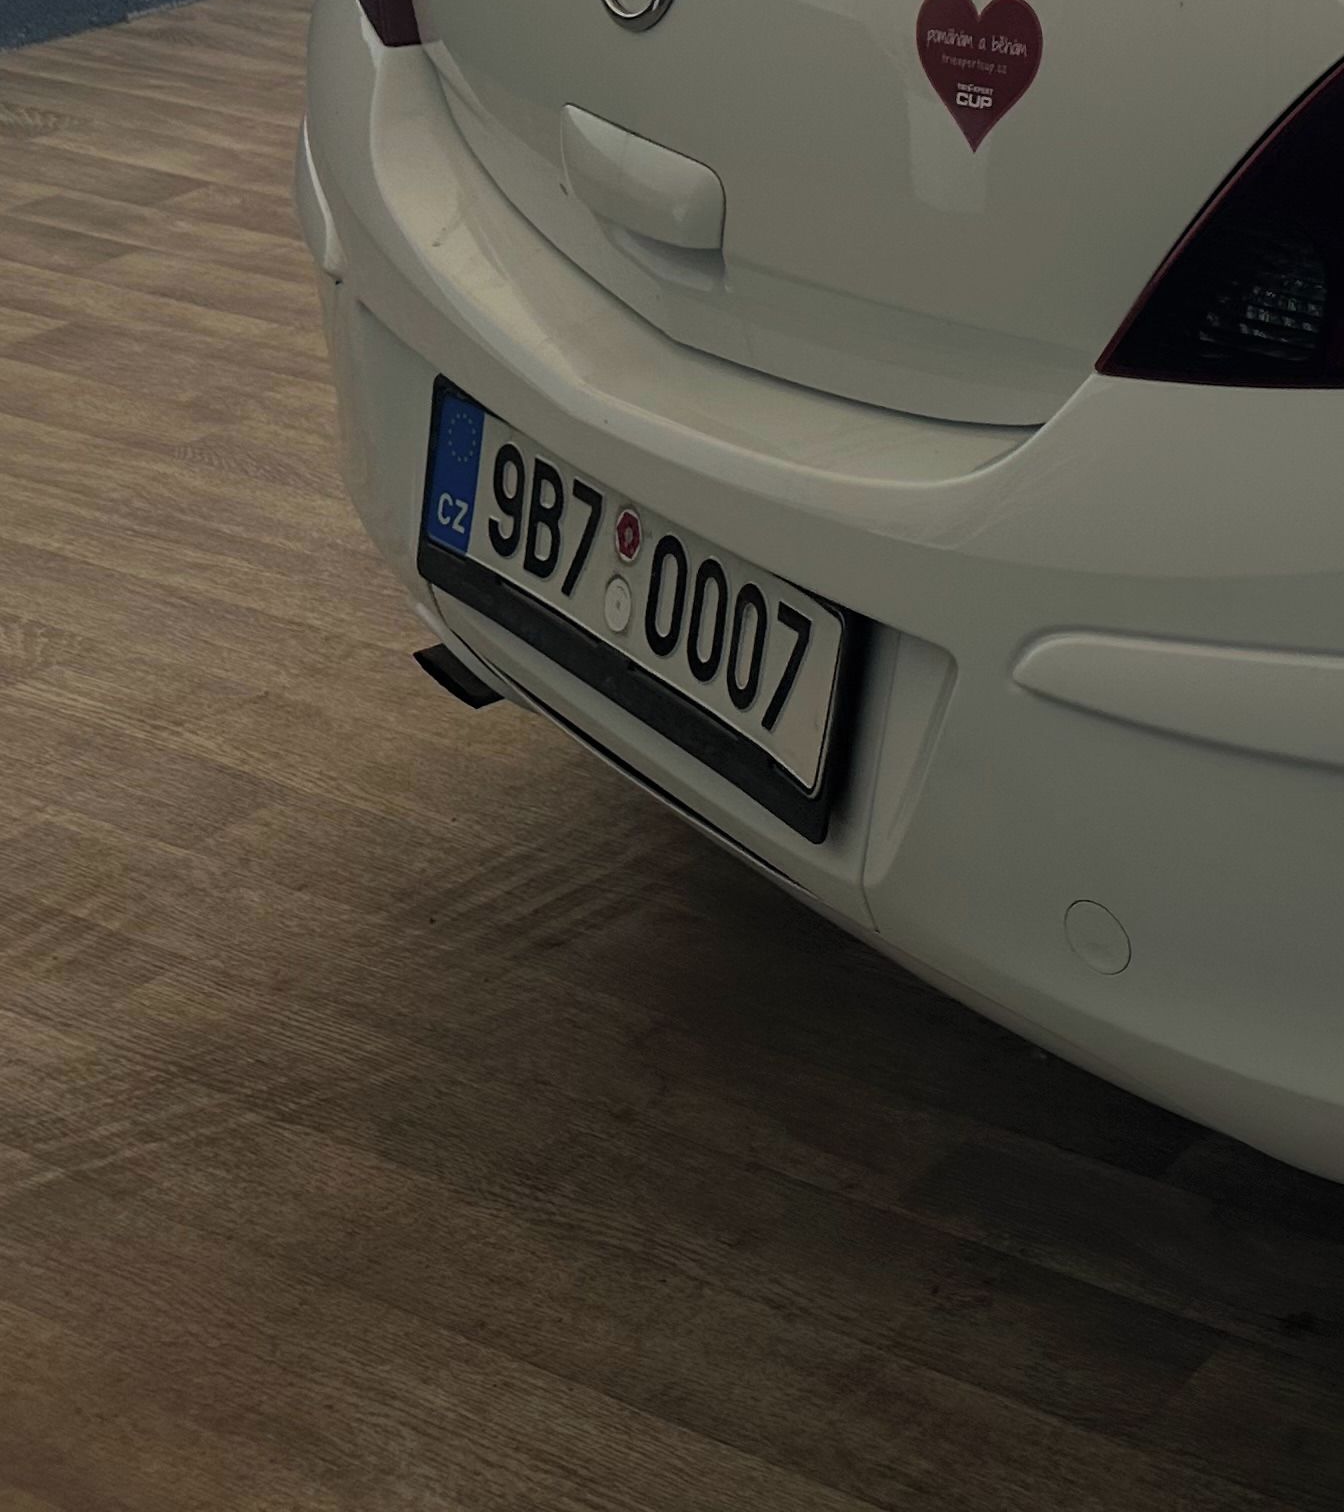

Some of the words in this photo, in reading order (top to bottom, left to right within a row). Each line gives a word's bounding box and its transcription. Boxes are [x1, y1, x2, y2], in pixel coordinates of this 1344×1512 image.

[956, 92, 992, 109] CUP
[437, 491, 469, 534] CZ
[488, 442, 604, 597] 9B7
[645, 534, 812, 732] 0007
